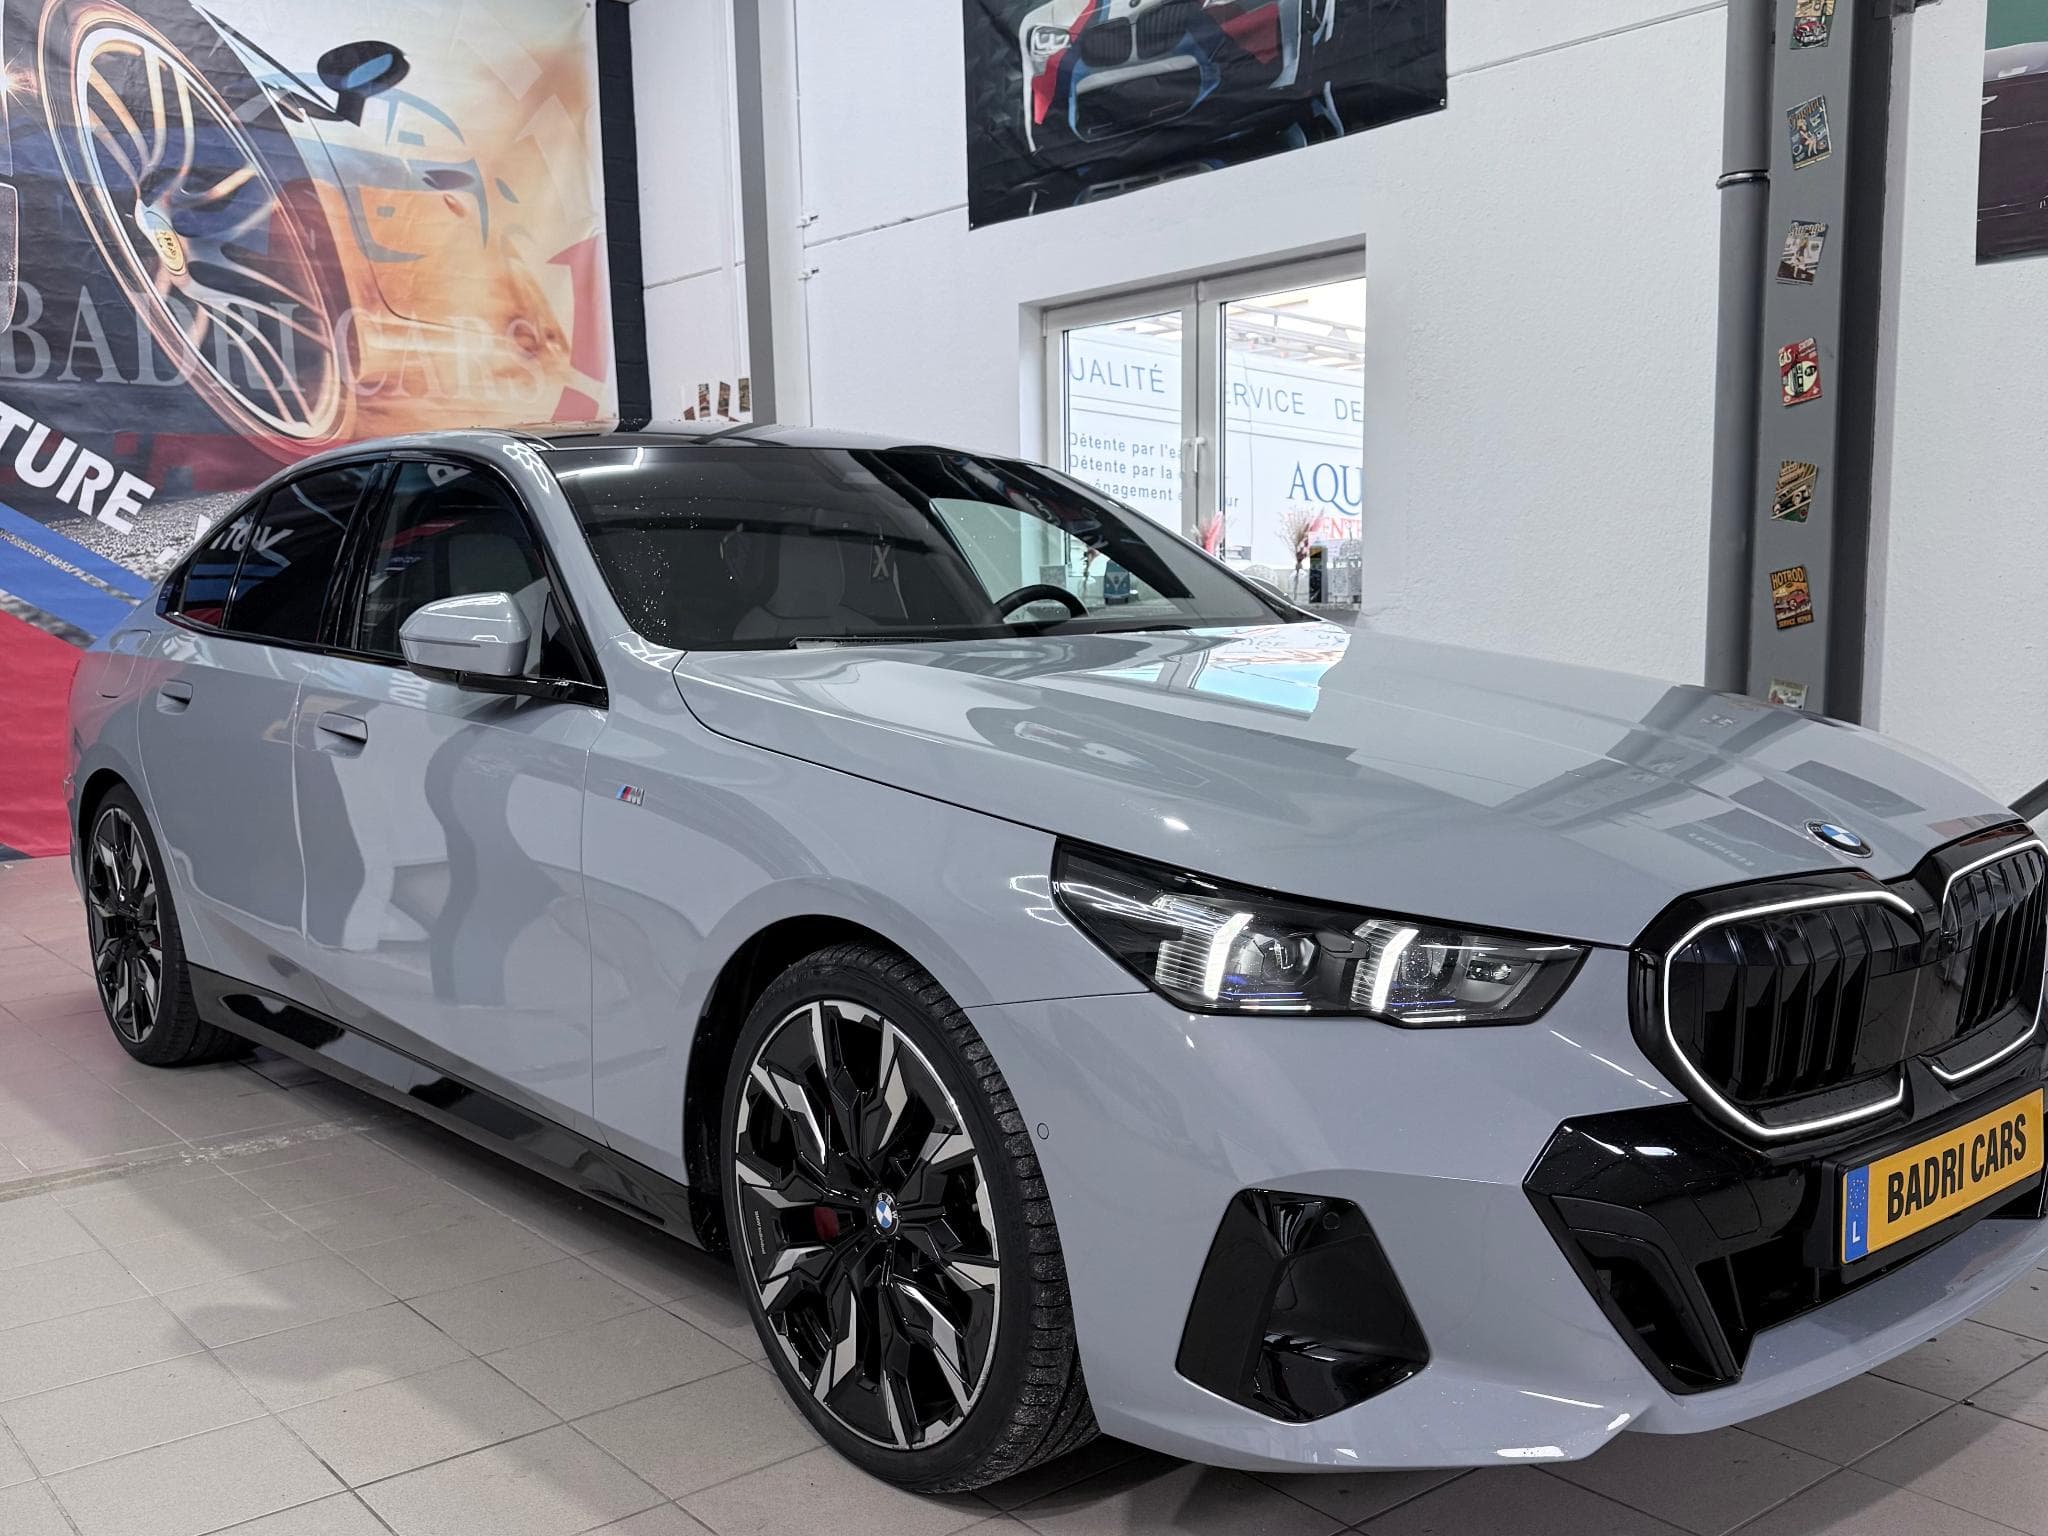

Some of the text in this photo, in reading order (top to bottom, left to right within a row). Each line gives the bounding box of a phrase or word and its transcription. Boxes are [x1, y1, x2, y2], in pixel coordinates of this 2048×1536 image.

[0, 281, 547, 402] BADRI CARS
[1132, 443, 1155, 456] par
[0, 401, 155, 535] TURE
[1132, 465, 1155, 479] par
[1160, 465, 1173, 480] la
[1771, 567, 1804, 590] HOTROD
[1887, 1113, 2027, 1224] BADRI CARS
[1852, 1221, 1861, 1243] L
